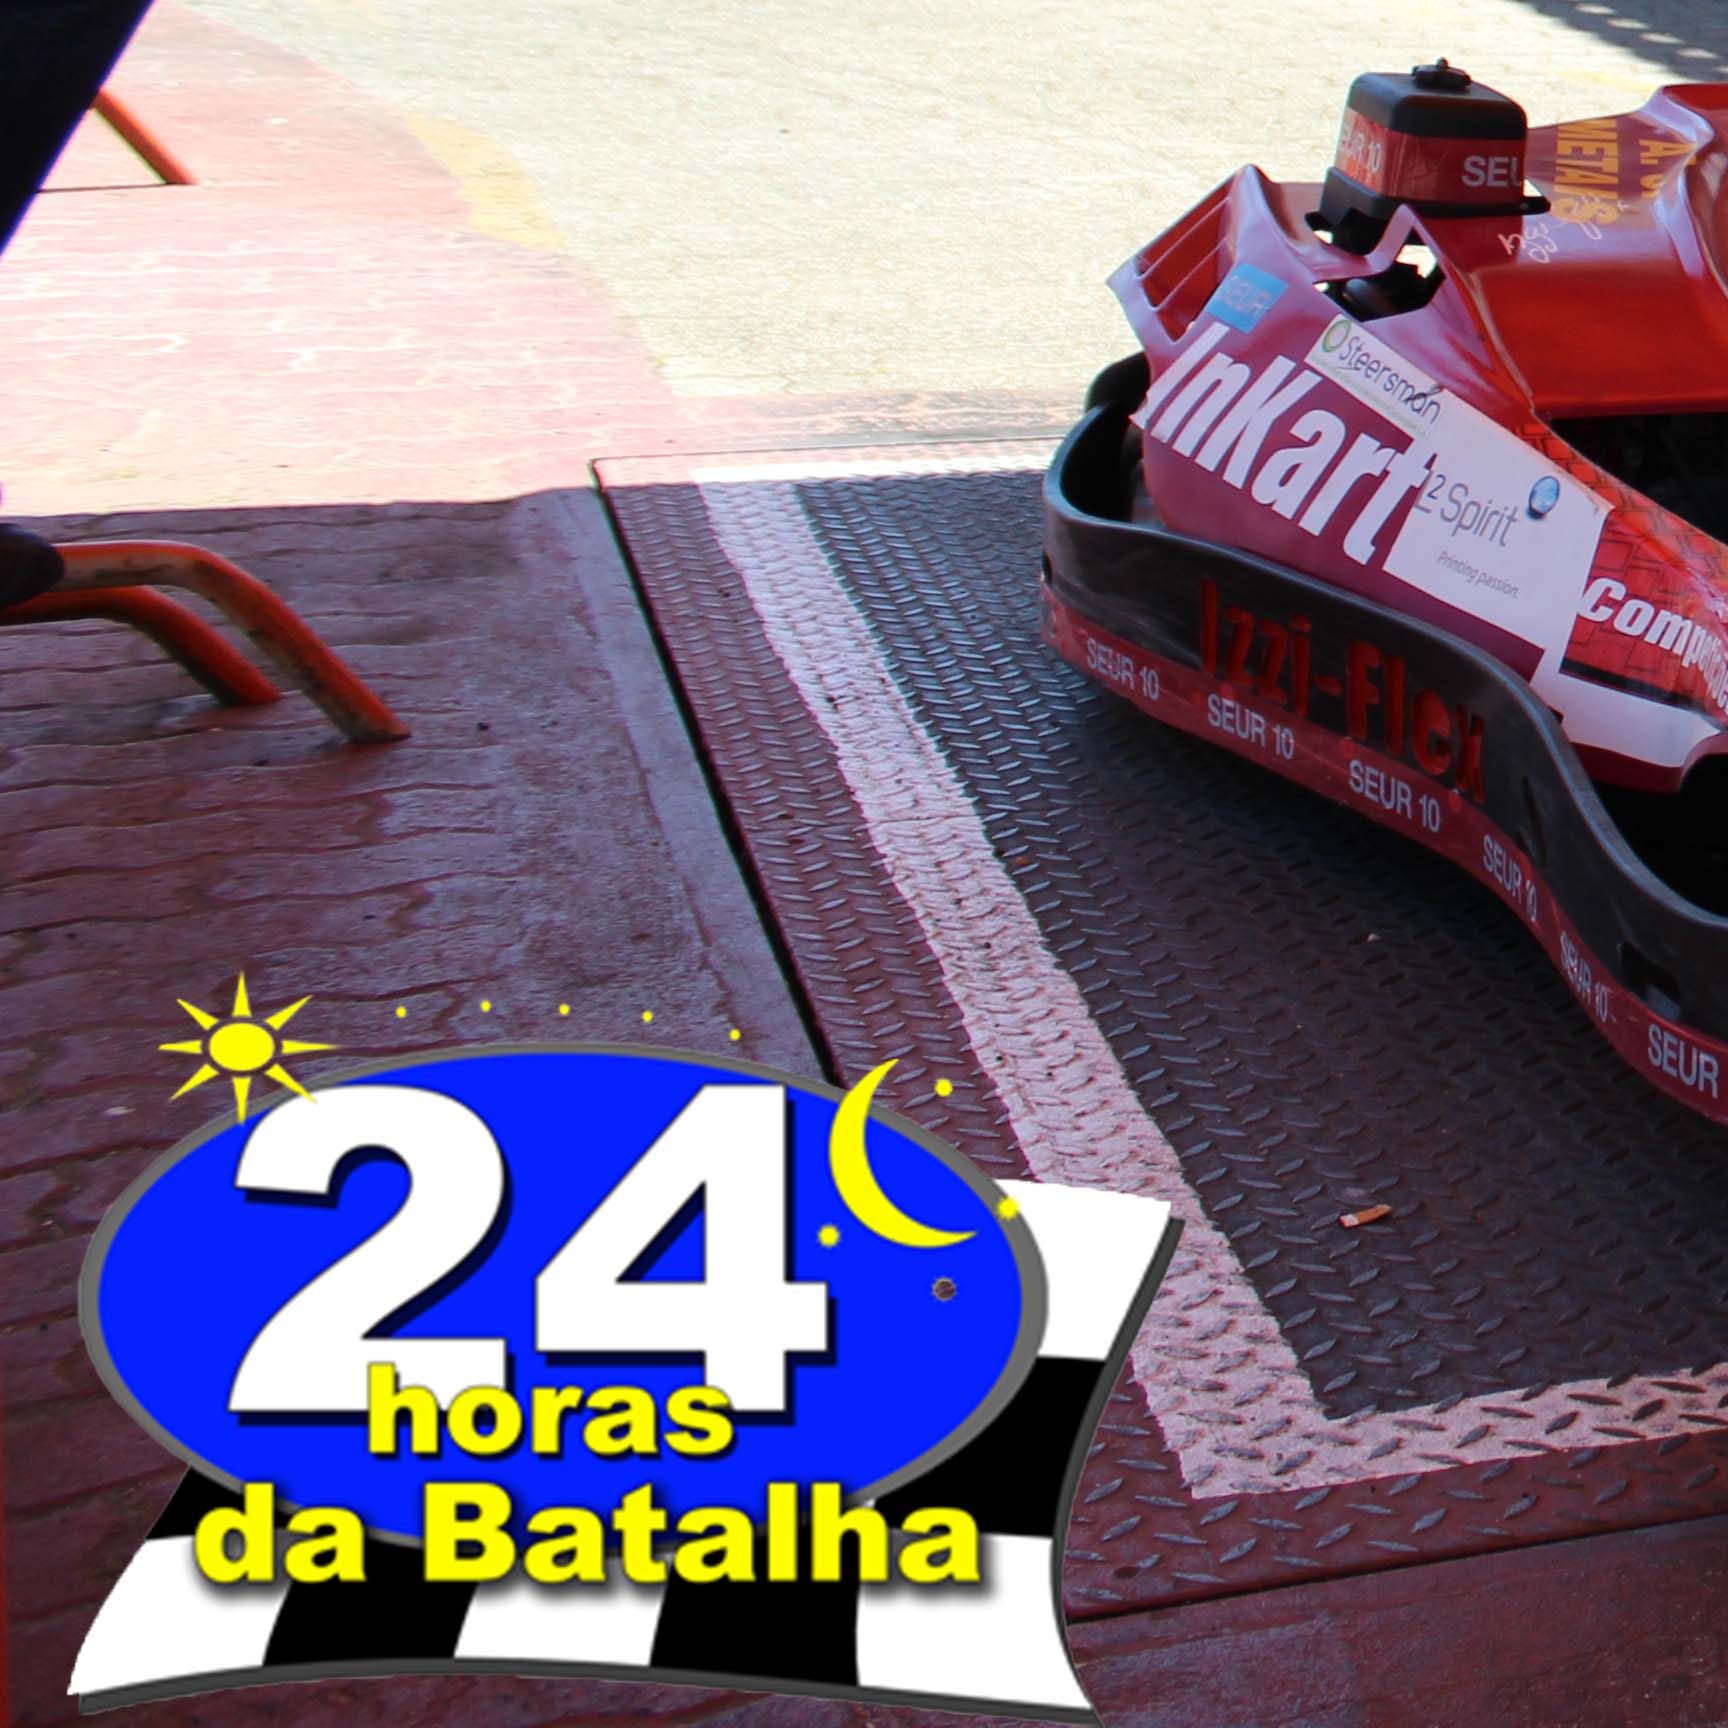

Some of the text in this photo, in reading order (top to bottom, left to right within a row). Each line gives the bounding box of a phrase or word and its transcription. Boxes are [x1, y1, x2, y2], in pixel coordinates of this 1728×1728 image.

[1339, 335, 1441, 425] Steersman
[1439, 481, 1518, 548] Spirit
[1086, 637, 1160, 701] SEUR 10
[1207, 692, 1296, 760] SEUR 10
[1348, 759, 1441, 834] SEUR 10
[1483, 834, 1522, 905] SEUR
[1647, 1022, 1720, 1095] SEUR
